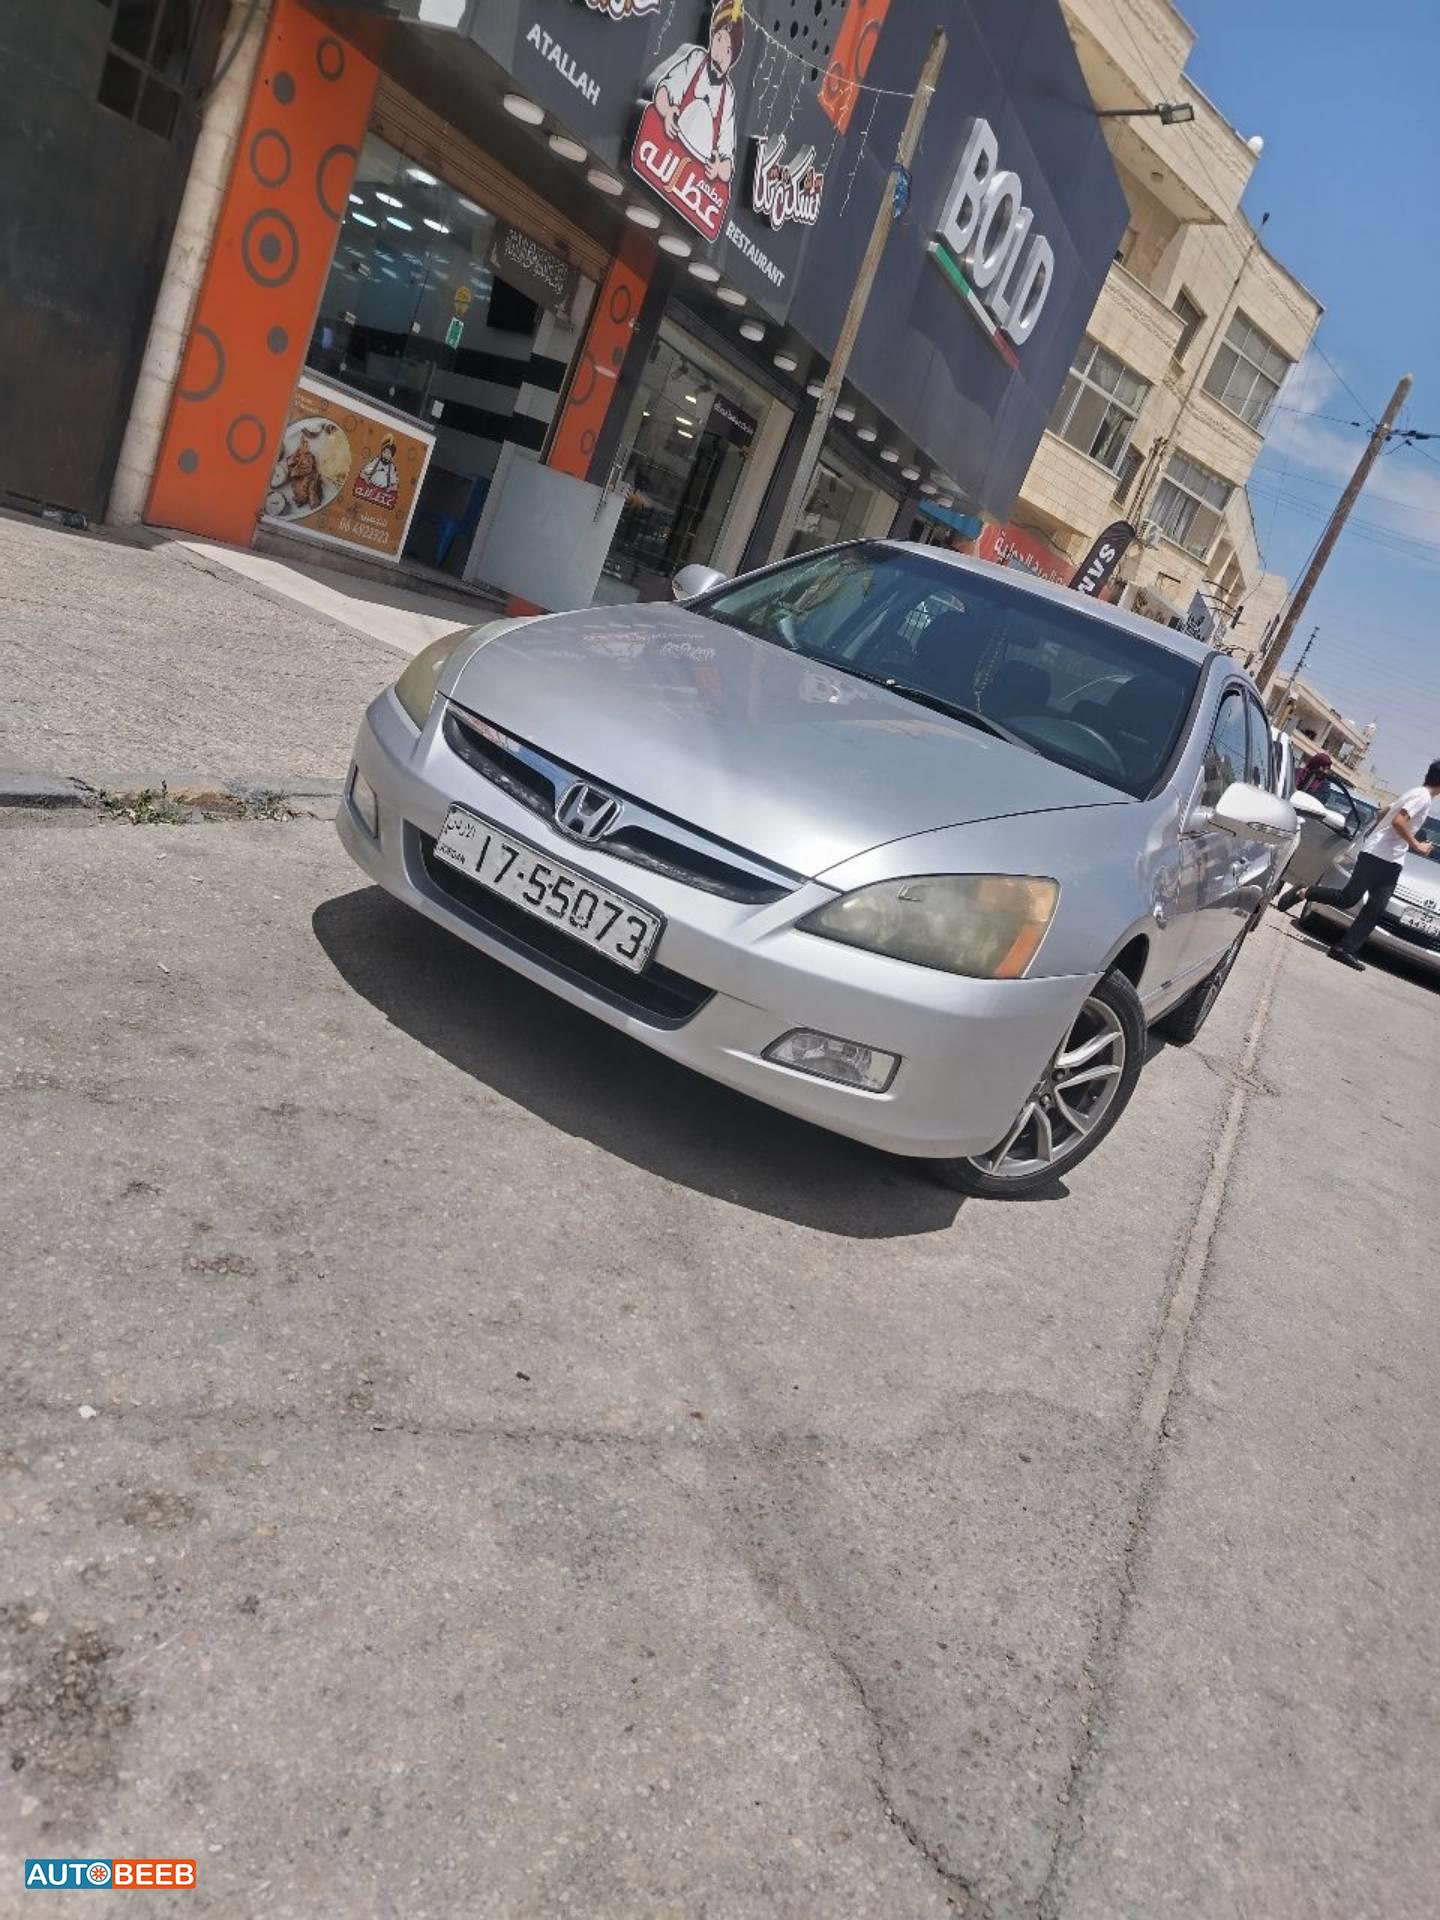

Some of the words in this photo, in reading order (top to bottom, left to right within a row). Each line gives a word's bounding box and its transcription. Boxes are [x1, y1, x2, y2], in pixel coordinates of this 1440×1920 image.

[525, 23, 601, 106] ATALLAH
[725, 220, 786, 289] RESTAURANT
[936, 118, 1054, 346] BOLD
[474, 834, 649, 961] 17-55073
